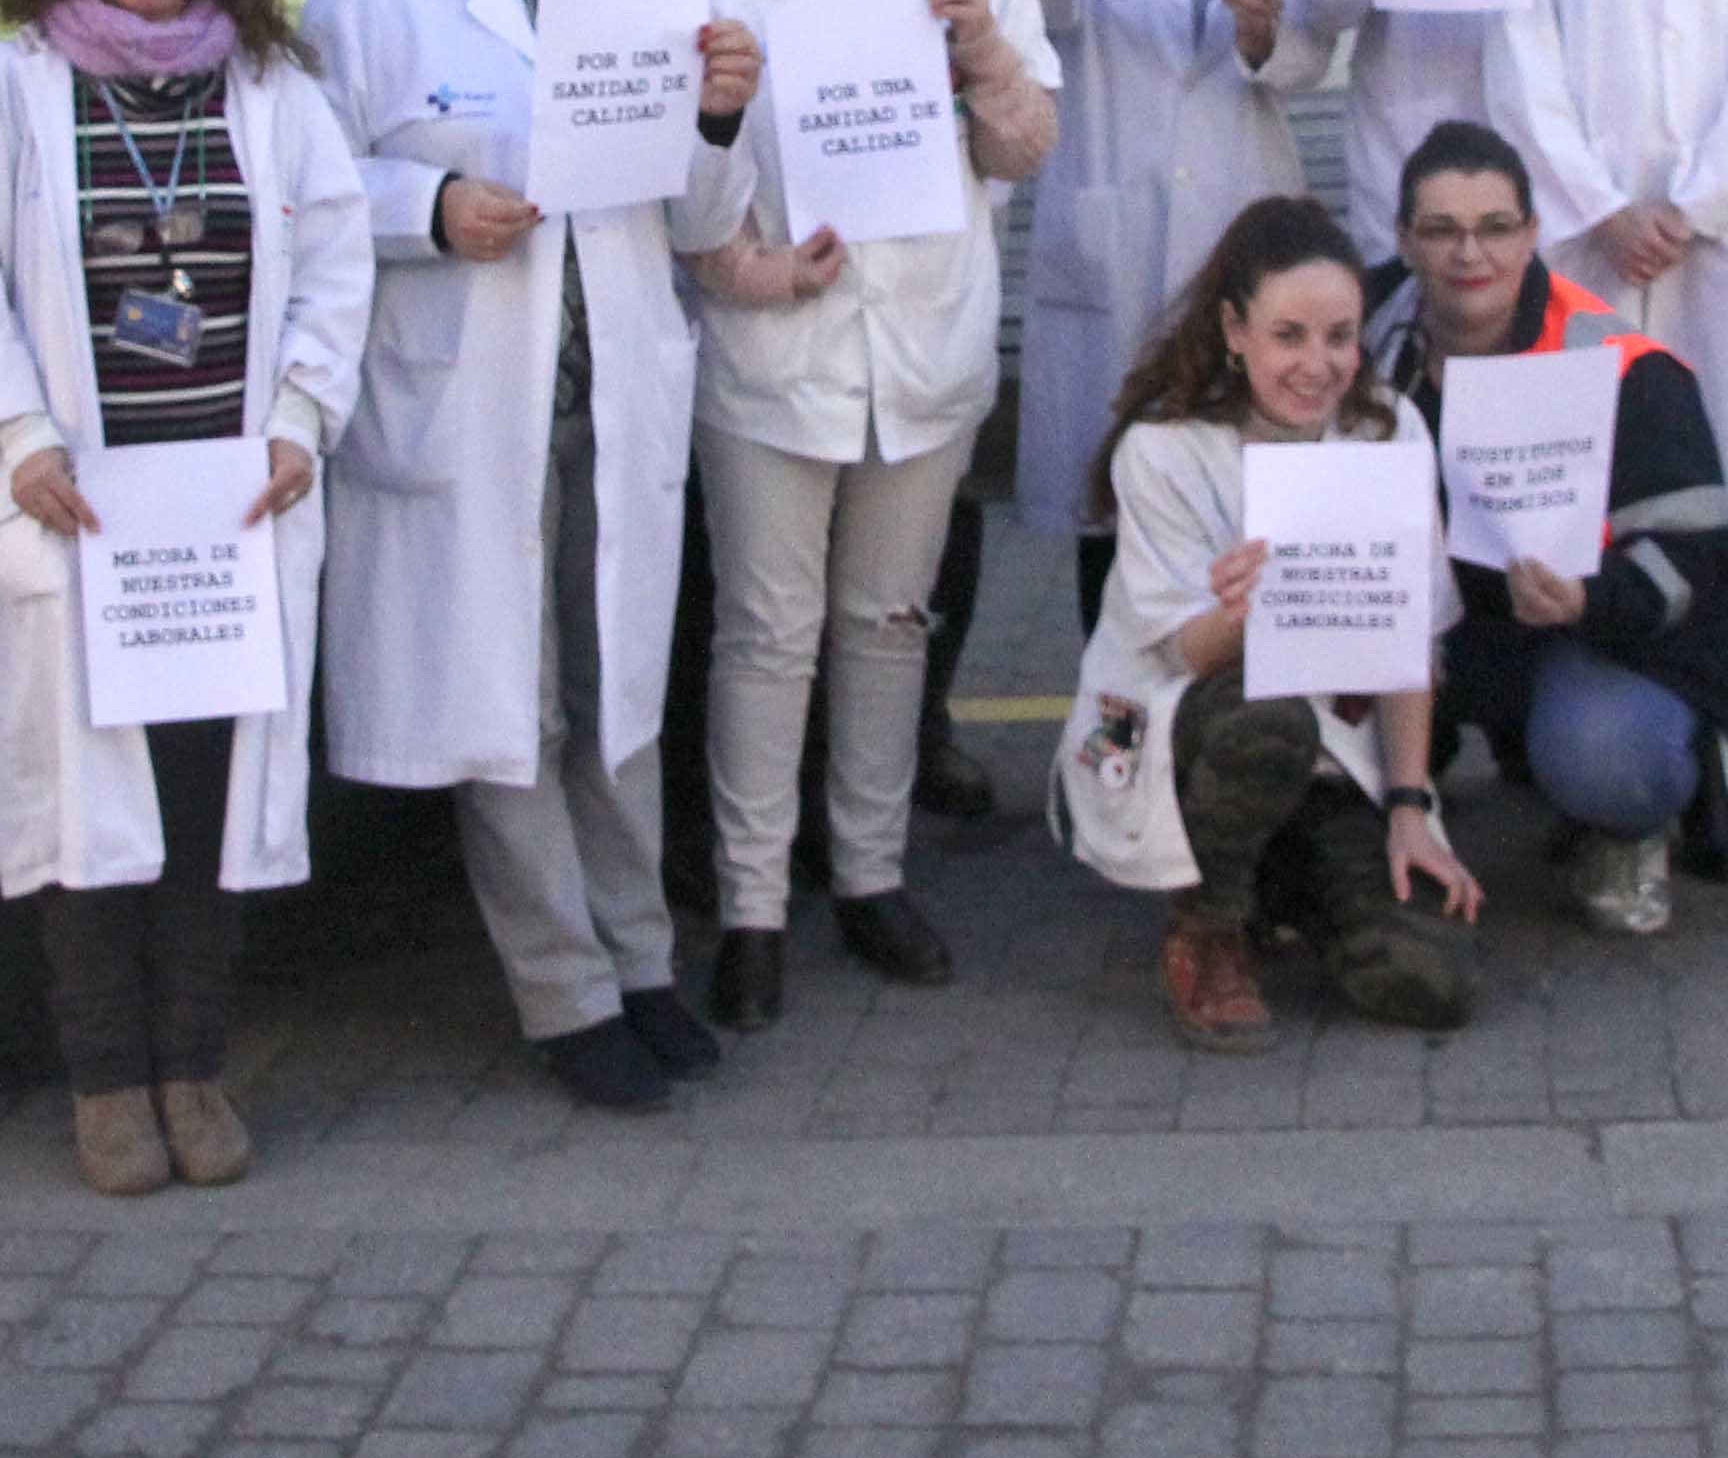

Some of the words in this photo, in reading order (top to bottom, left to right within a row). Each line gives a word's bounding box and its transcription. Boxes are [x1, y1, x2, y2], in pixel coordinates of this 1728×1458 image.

[577, 52, 618, 71] POR
[632, 50, 670, 68] UNA
[553, 77, 650, 100] SANIDAD
[662, 74, 688, 92] DE
[818, 84, 859, 103] POR
[872, 77, 916, 96] UNA
[571, 103, 666, 126] CALIDAD
[799, 106, 897, 132] SANIDAD
[911, 101, 939, 120] DE
[822, 130, 921, 156] CALIDAD
[113, 545, 198, 568] MEJORA
[210, 543, 239, 562] DE
[1274, 542, 1356, 559] MEJORA
[1370, 542, 1397, 557] DE
[120, 570, 233, 594] NUESTRAS
[1281, 566, 1390, 581] NUESTRAS
[101, 595, 257, 622] CONDICIONES
[1261, 590, 1410, 606] CONDICIONES
[1274, 613, 1395, 629] LABORALES
[119, 623, 245, 649] LABORALES
